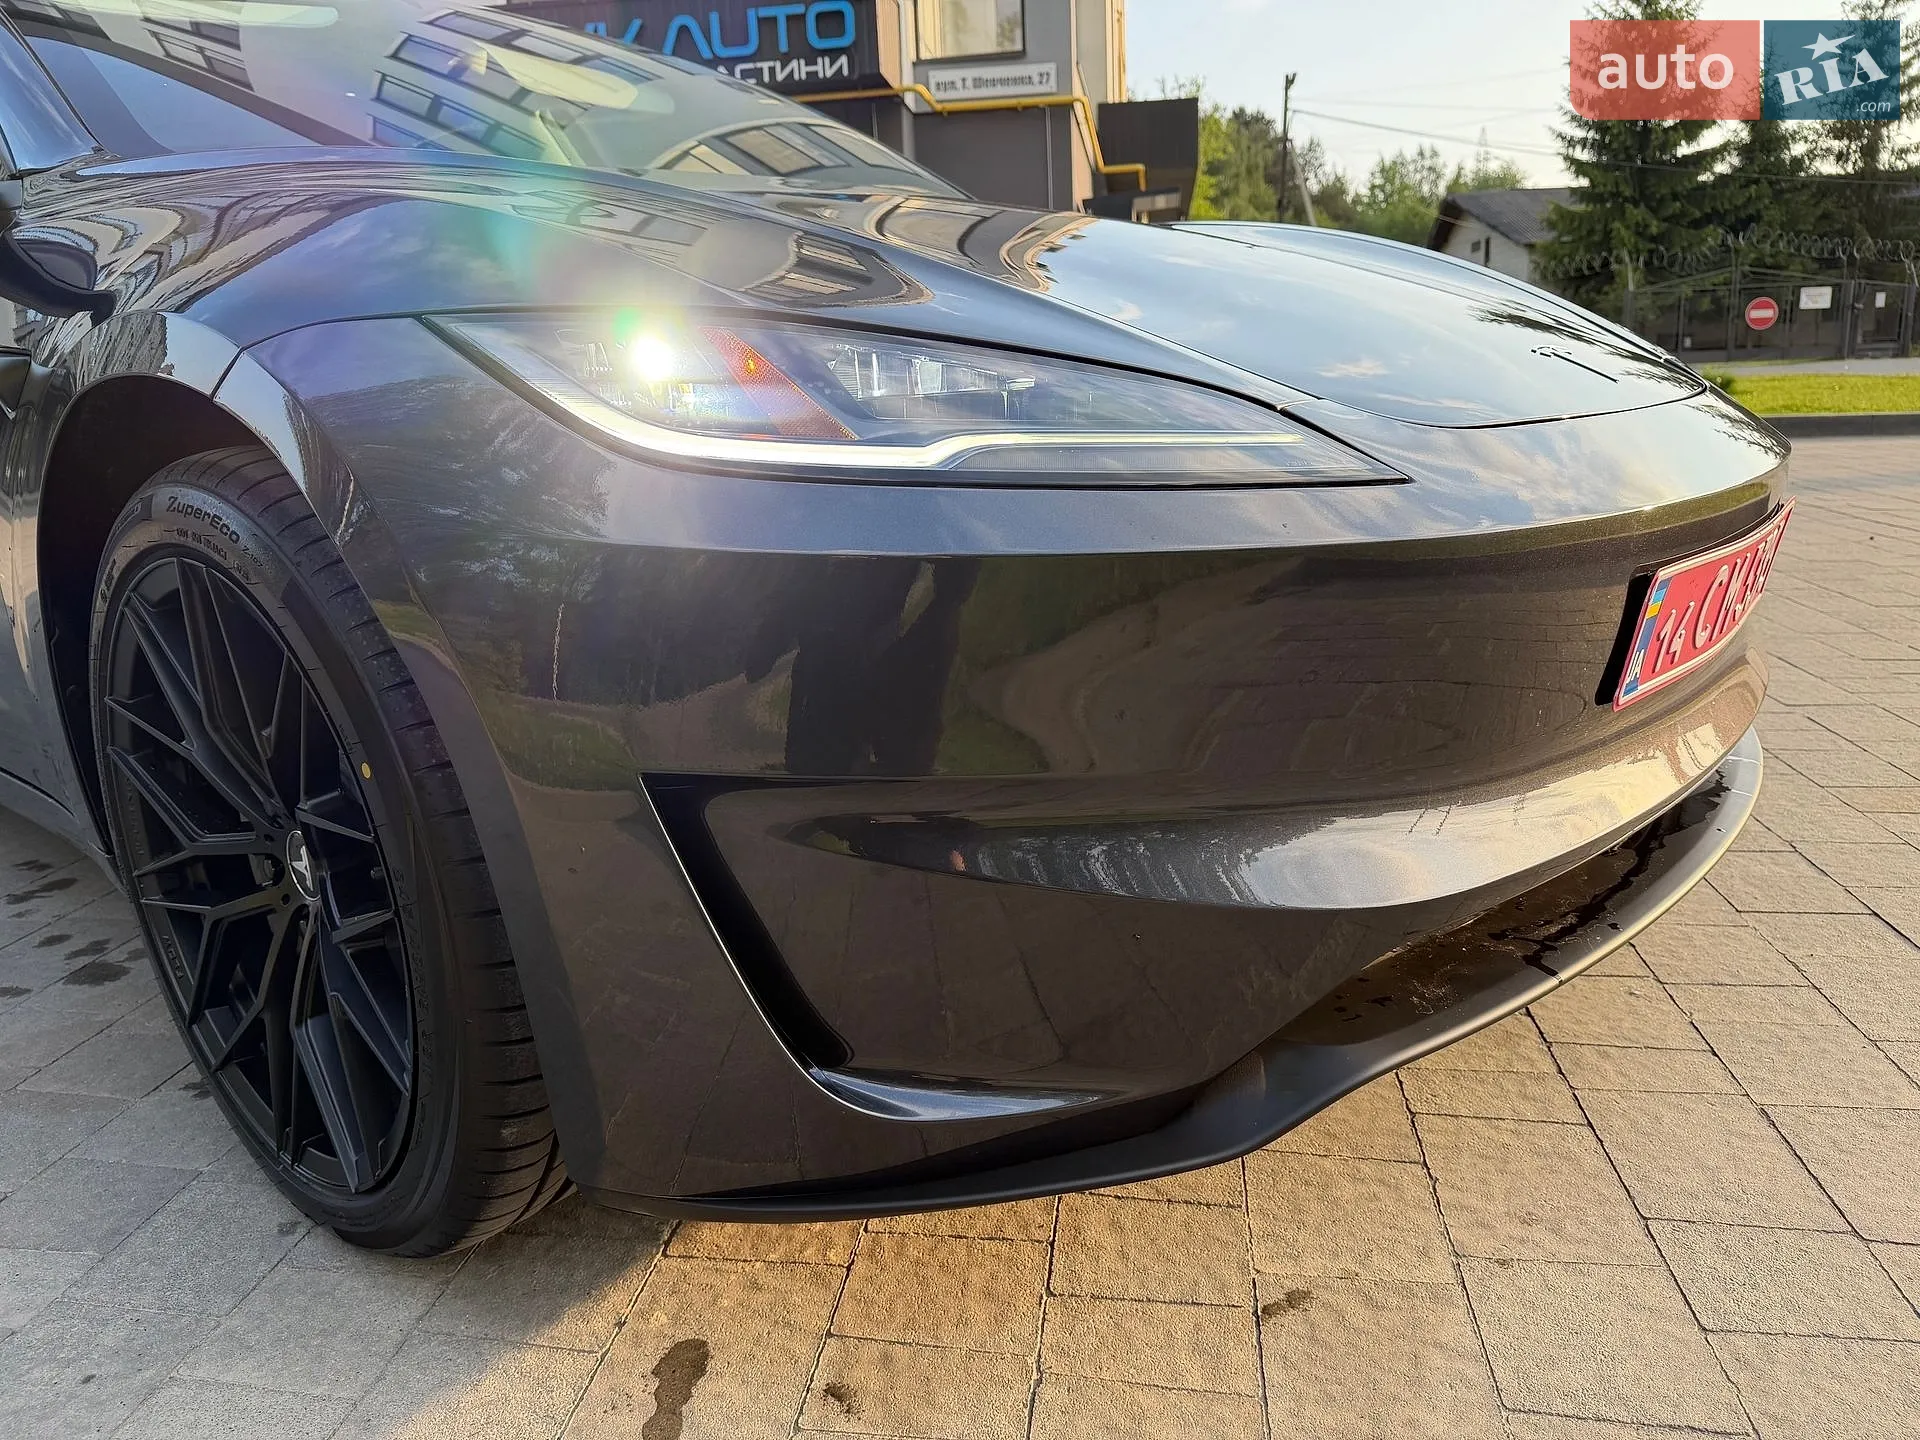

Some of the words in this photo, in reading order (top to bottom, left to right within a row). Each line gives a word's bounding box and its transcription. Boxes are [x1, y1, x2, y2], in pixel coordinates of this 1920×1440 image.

[662, 0, 857, 60] AUTO
[717, 54, 849, 84] СТИНИ
[1037, 71, 1051, 86] 27
[166, 496, 240, 544] ZuperEco
[1652, 601, 1695, 673] 14
